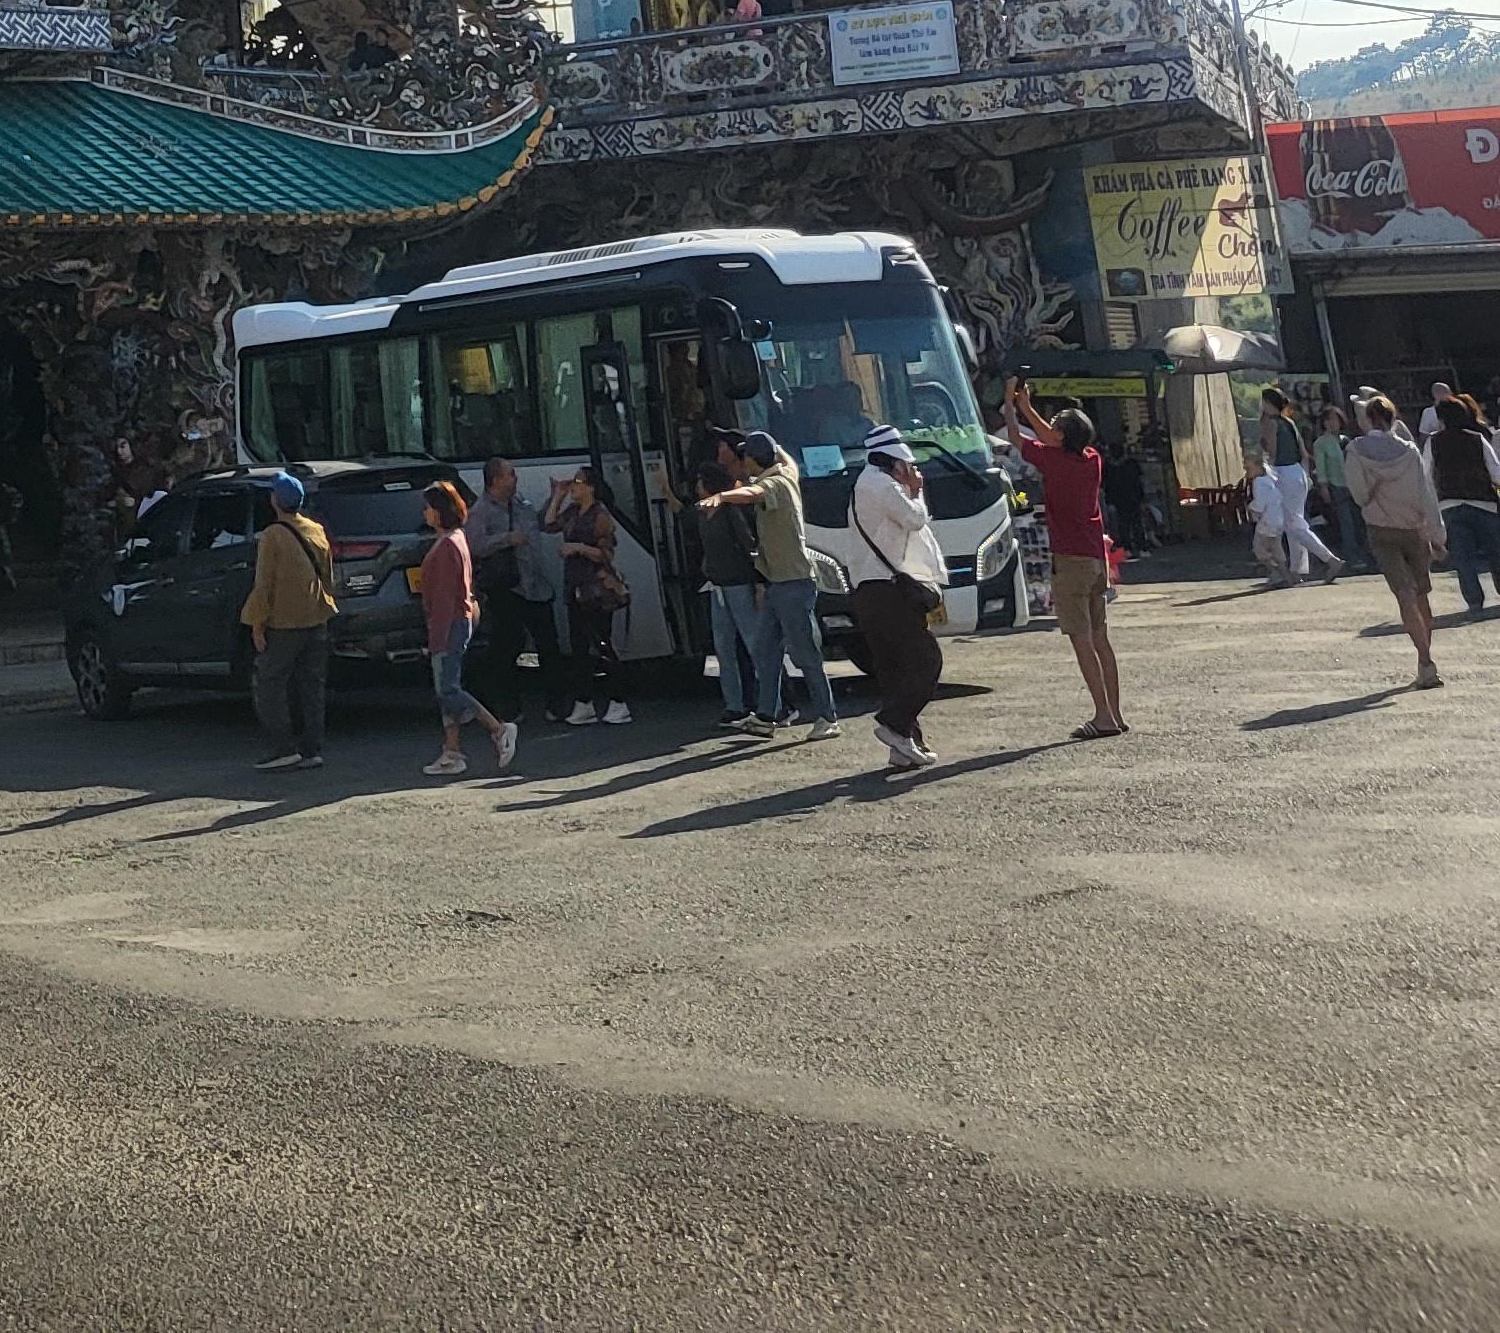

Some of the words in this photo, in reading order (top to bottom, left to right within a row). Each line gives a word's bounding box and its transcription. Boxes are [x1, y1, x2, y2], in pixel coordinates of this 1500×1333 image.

[1176, 164, 1201, 189] PHÊ
[1305, 160, 1407, 198] Coca-Cola
[1117, 196, 1206, 261] Coffee
